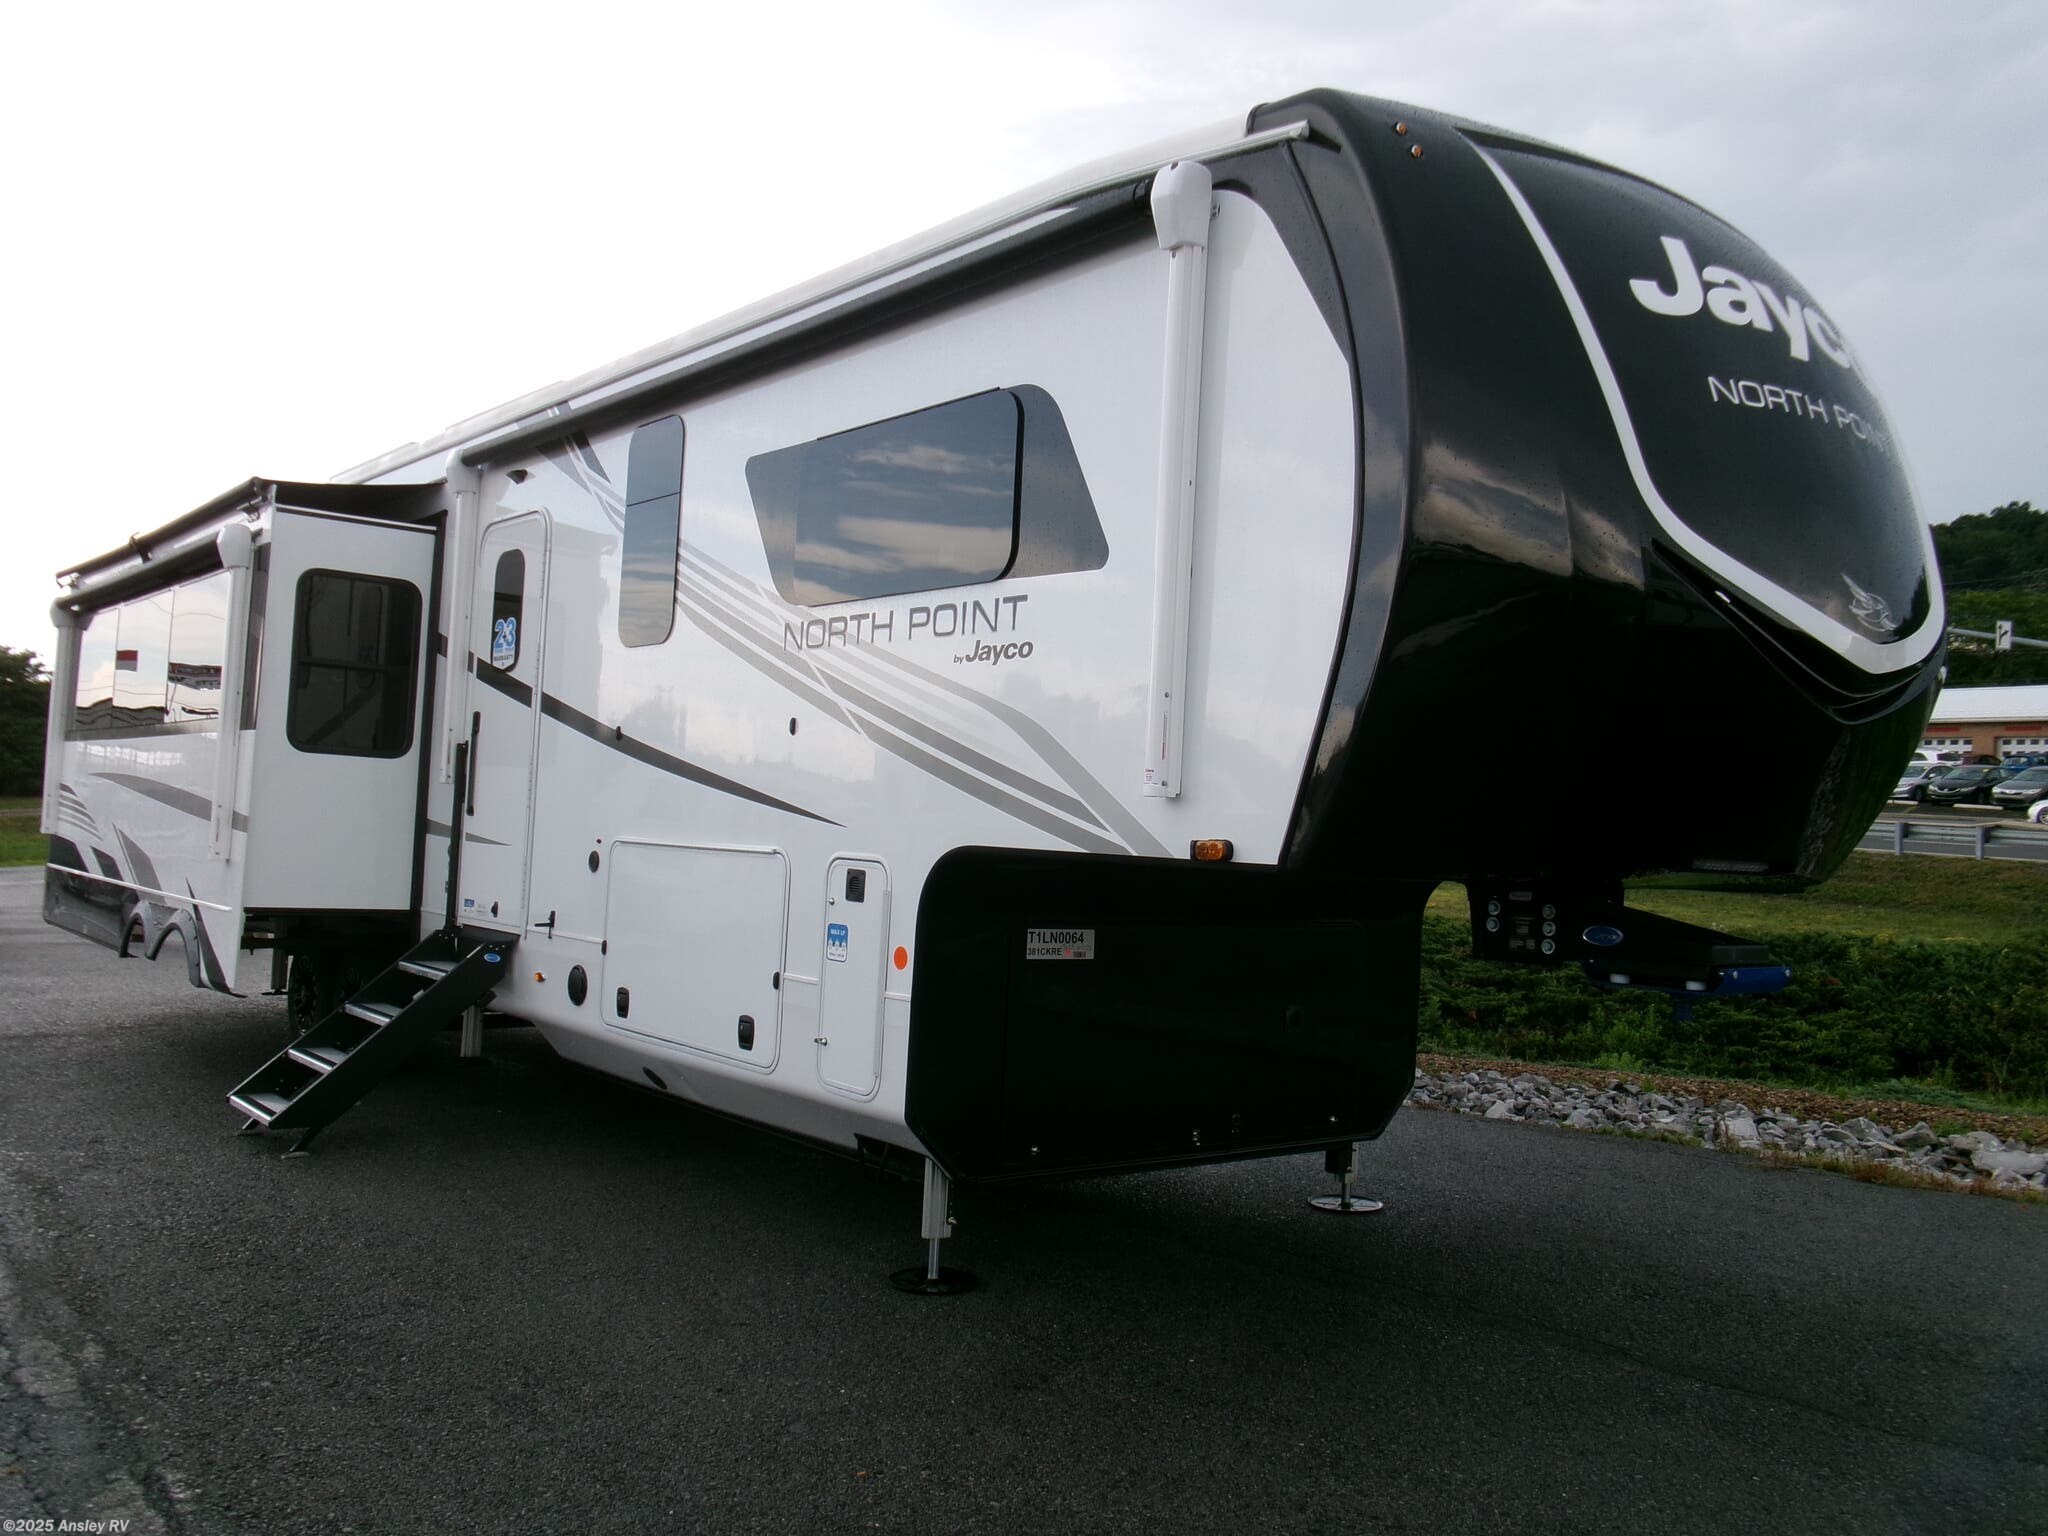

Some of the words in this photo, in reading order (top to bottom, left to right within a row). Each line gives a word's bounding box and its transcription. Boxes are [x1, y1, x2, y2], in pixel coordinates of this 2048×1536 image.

[1629, 235, 1860, 376] Jayc
[1707, 375, 1829, 424] NORTH
[783, 610, 895, 652] NORTH
[908, 594, 1029, 641] POINT
[953, 653, 965, 665] by
[965, 639, 1034, 666] Jayco
[1028, 931, 1085, 944] T1LN0064
